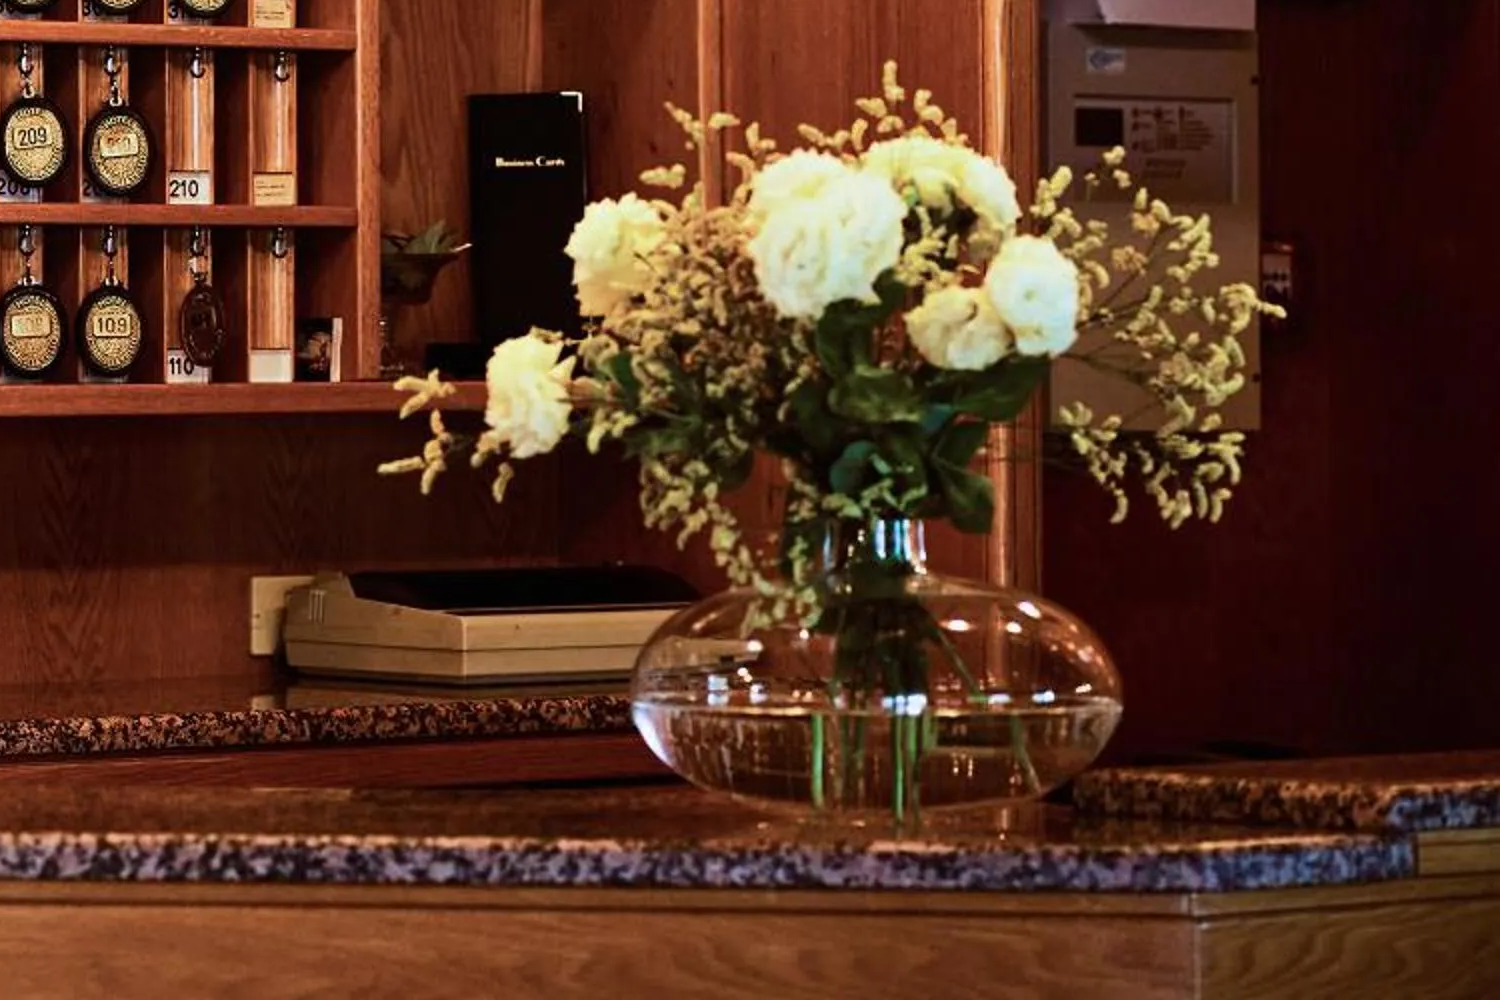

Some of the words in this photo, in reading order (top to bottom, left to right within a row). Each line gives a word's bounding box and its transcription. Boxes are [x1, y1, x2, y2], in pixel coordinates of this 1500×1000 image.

[18, 128, 47, 147] 209
[169, 180, 199, 197] 210
[98, 317, 127, 334] 109
[169, 358, 195, 375] 110
